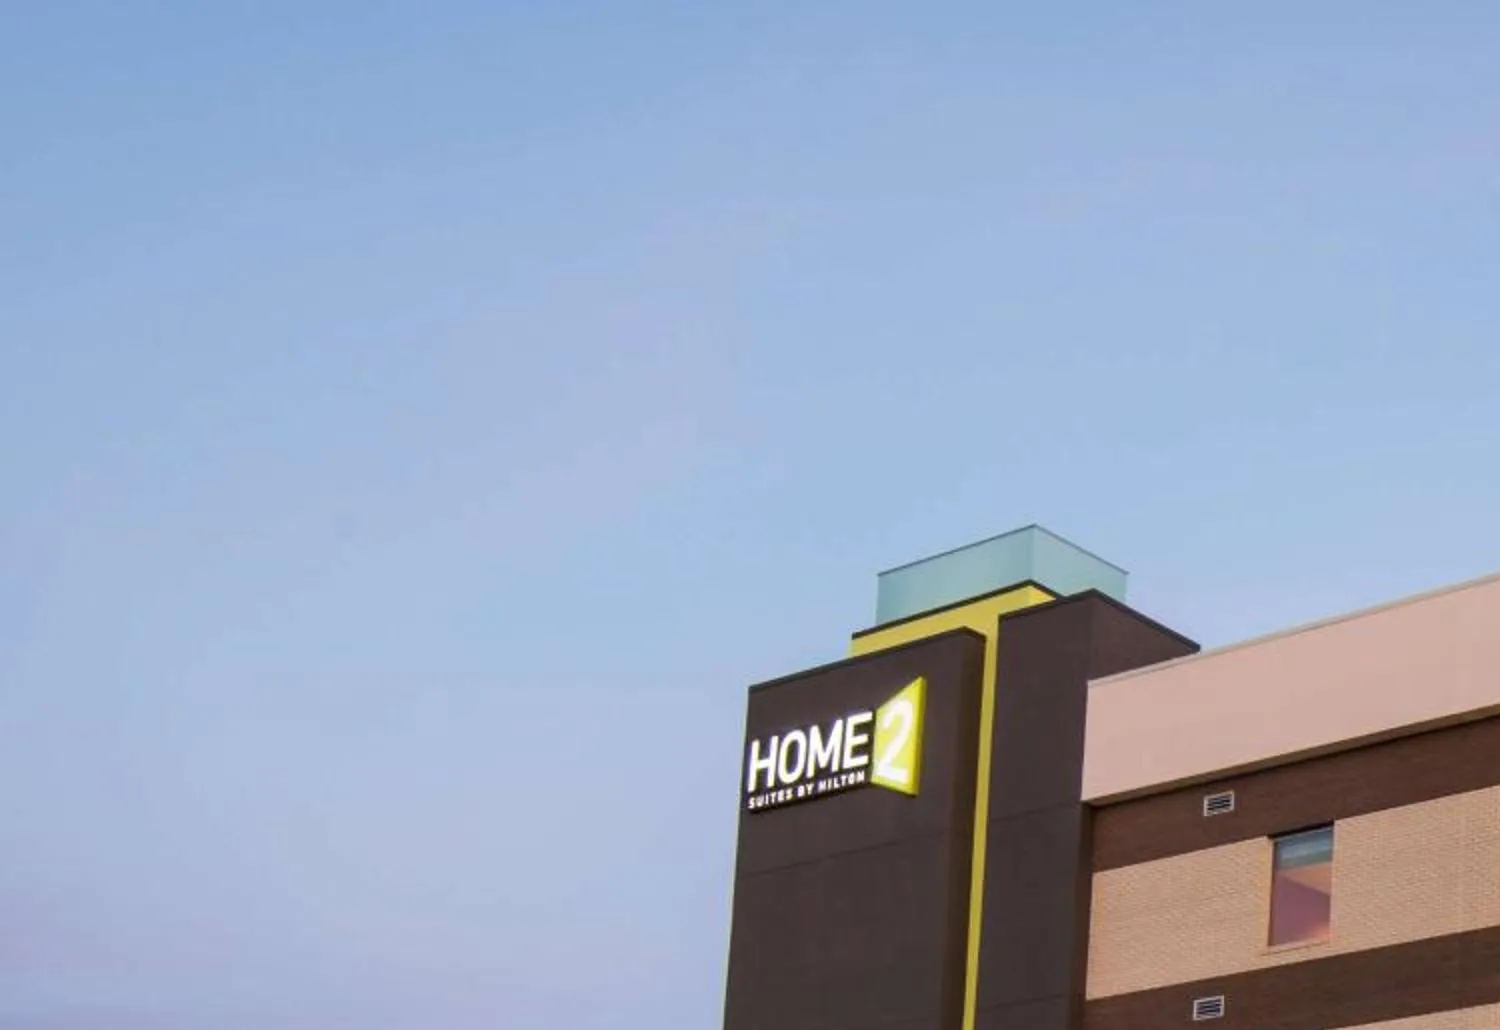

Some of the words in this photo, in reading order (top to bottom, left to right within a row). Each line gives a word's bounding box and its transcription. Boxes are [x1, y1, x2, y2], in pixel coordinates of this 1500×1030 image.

[748, 787, 793, 809] SUITES
[797, 783, 815, 797] BY
[818, 769, 866, 793] HILTON
